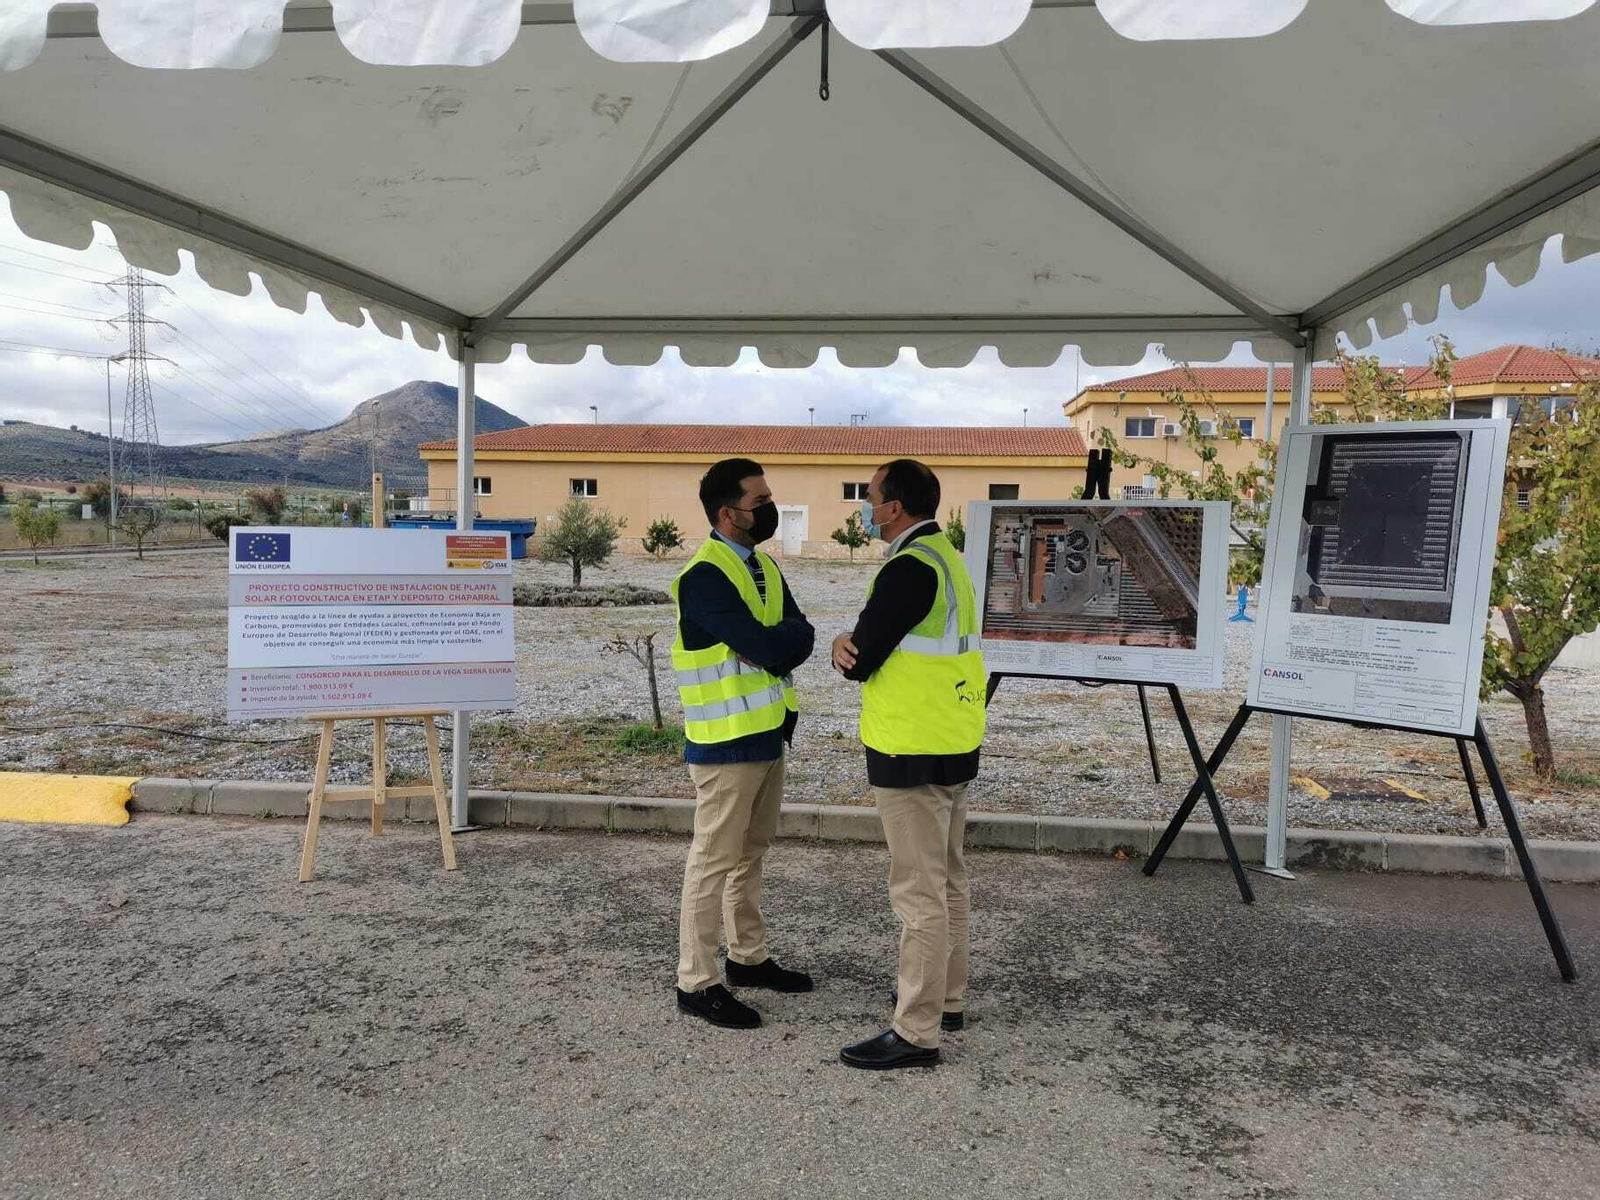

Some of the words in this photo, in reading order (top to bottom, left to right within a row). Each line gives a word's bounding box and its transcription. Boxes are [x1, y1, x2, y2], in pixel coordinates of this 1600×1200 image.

[464, 583, 497, 591] PLANTA
[329, 631, 361, 639] Regional
[1263, 667, 1305, 680] CANSOL
[250, 695, 277, 703] Importe
